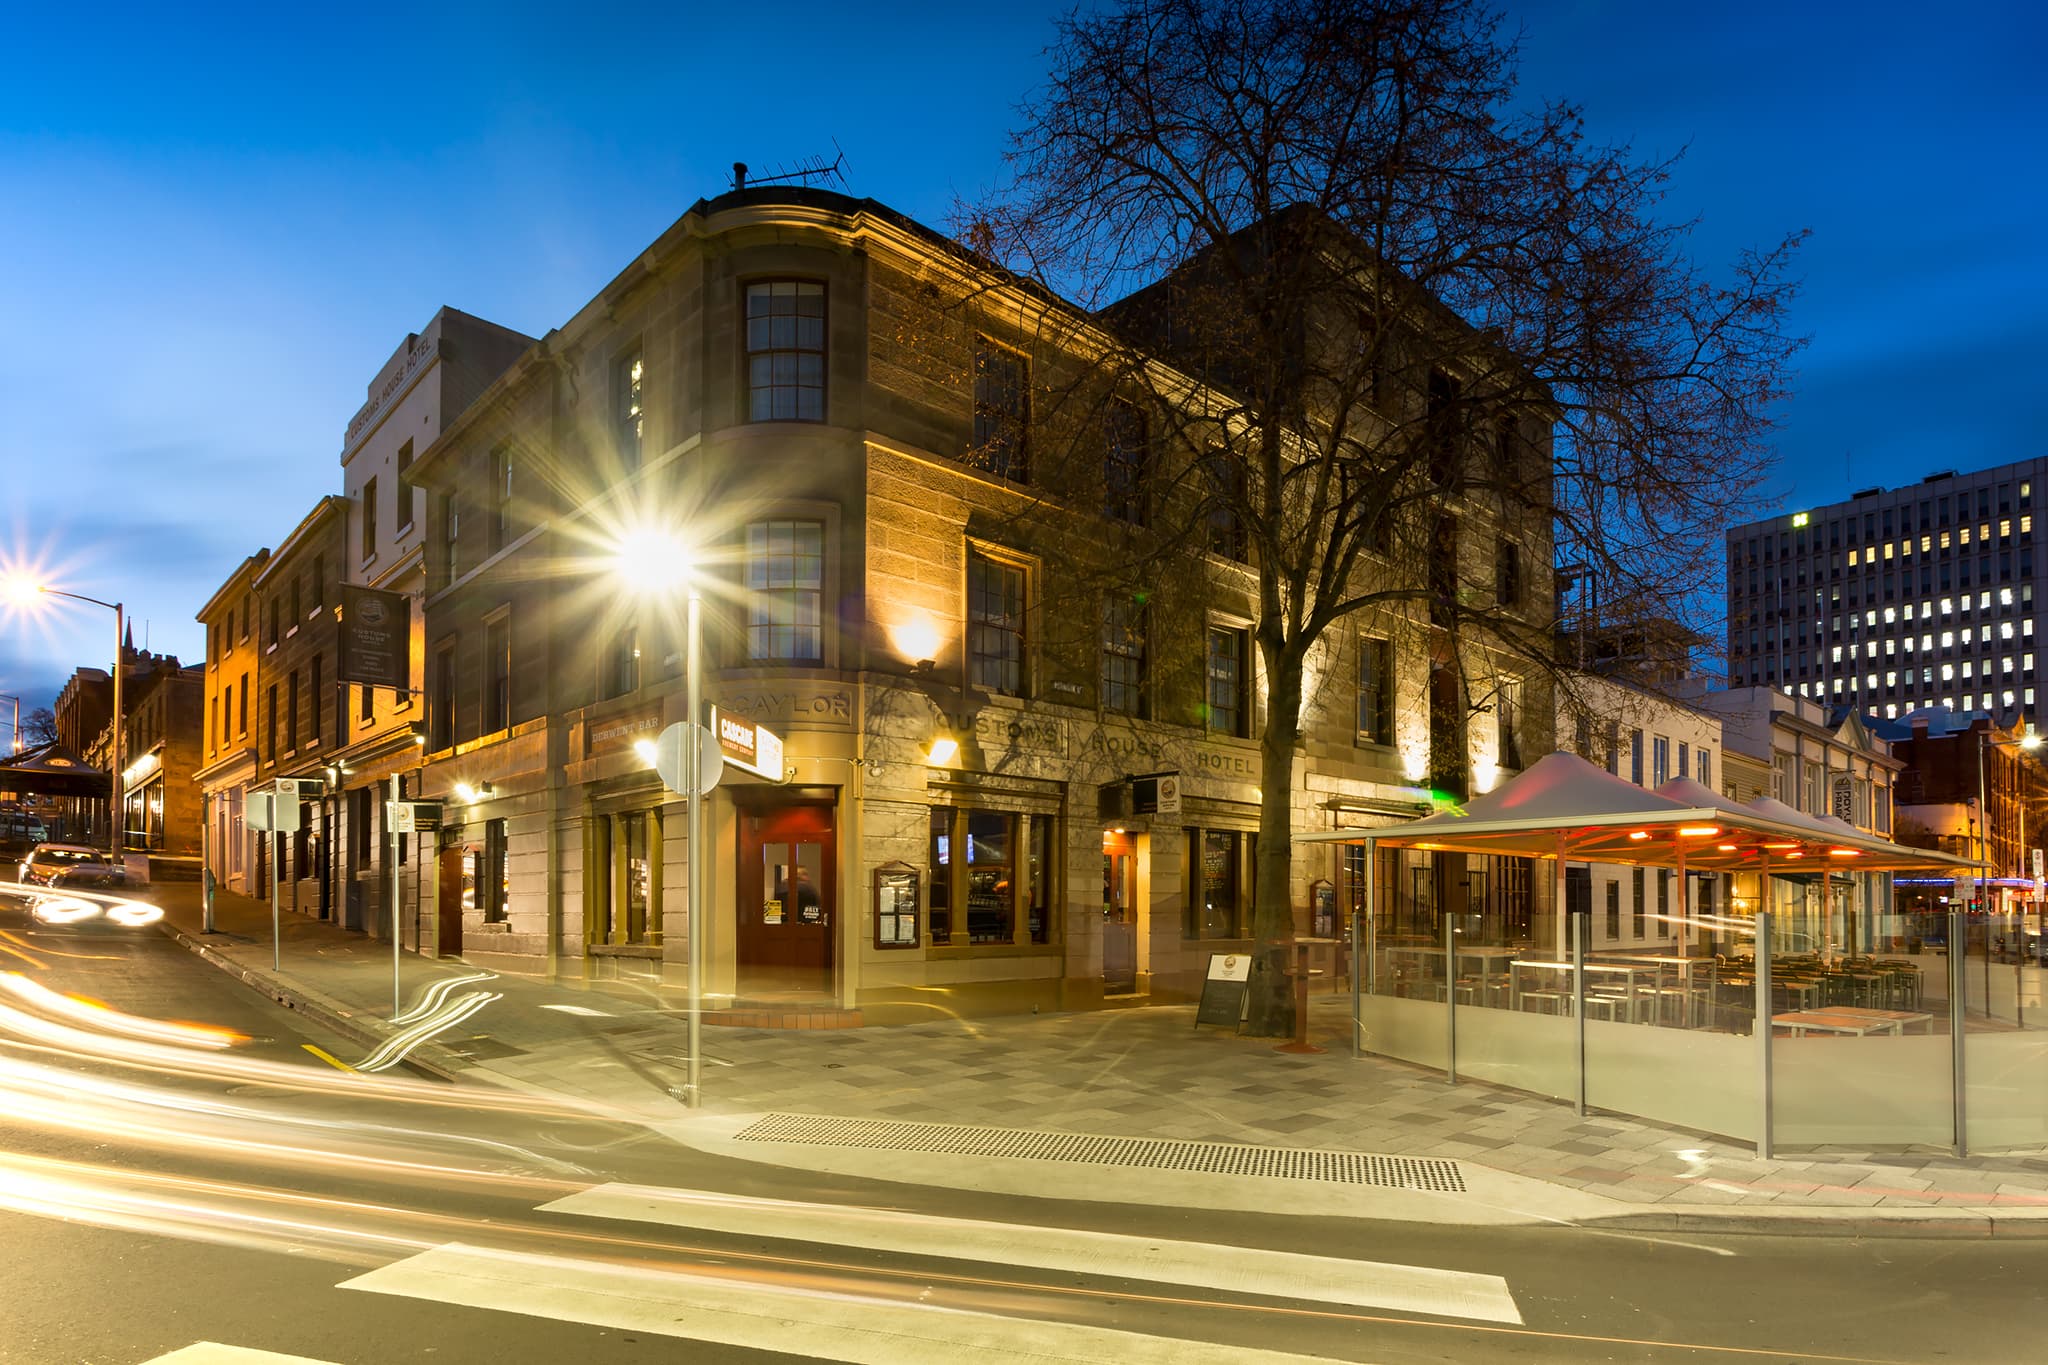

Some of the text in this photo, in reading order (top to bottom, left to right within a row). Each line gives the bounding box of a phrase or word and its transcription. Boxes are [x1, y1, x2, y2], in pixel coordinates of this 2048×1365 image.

[350, 337, 431, 439] CUSTOMS HOUSE HOTEL
[592, 717, 658, 742] DERWENT BAR
[721, 718, 754, 750] CASCADE
[935, 711, 1255, 774] CUSTOMS HOUSE HOTEL
